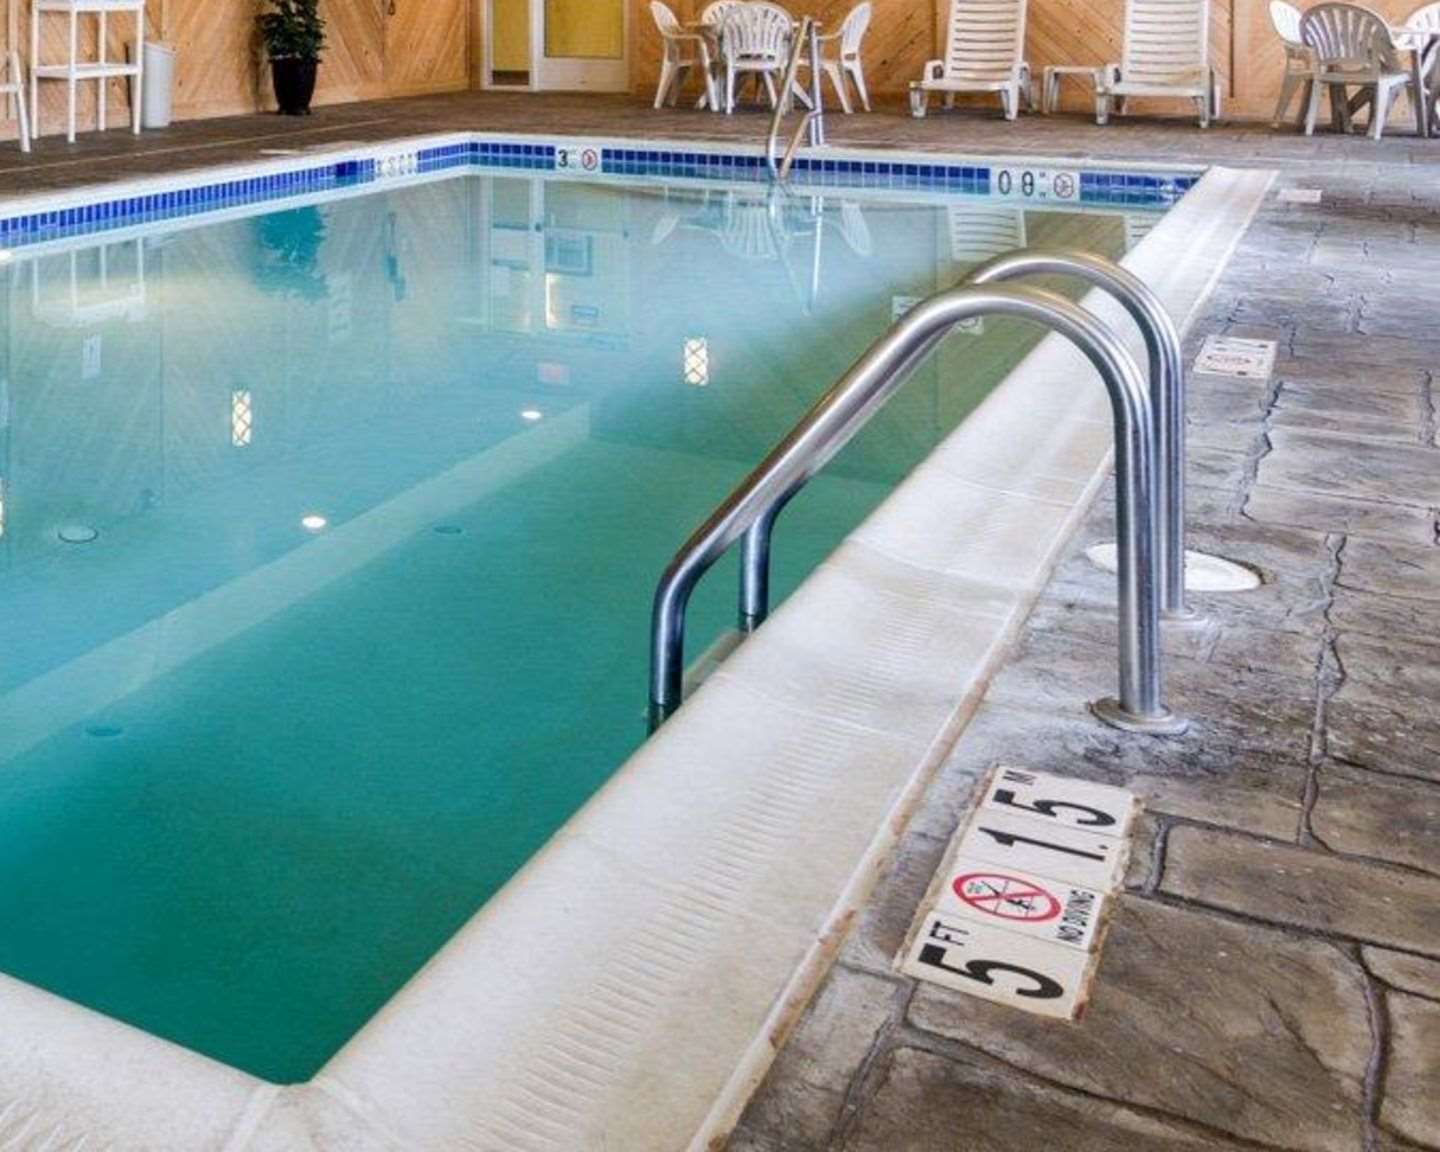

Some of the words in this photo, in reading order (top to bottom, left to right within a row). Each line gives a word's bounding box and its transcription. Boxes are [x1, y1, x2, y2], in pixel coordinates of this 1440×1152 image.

[1062, 889, 1097, 927] DIVING
[928, 920, 969, 946] FT
[1056, 924, 1086, 945] NO
[918, 943, 1064, 999] 5
